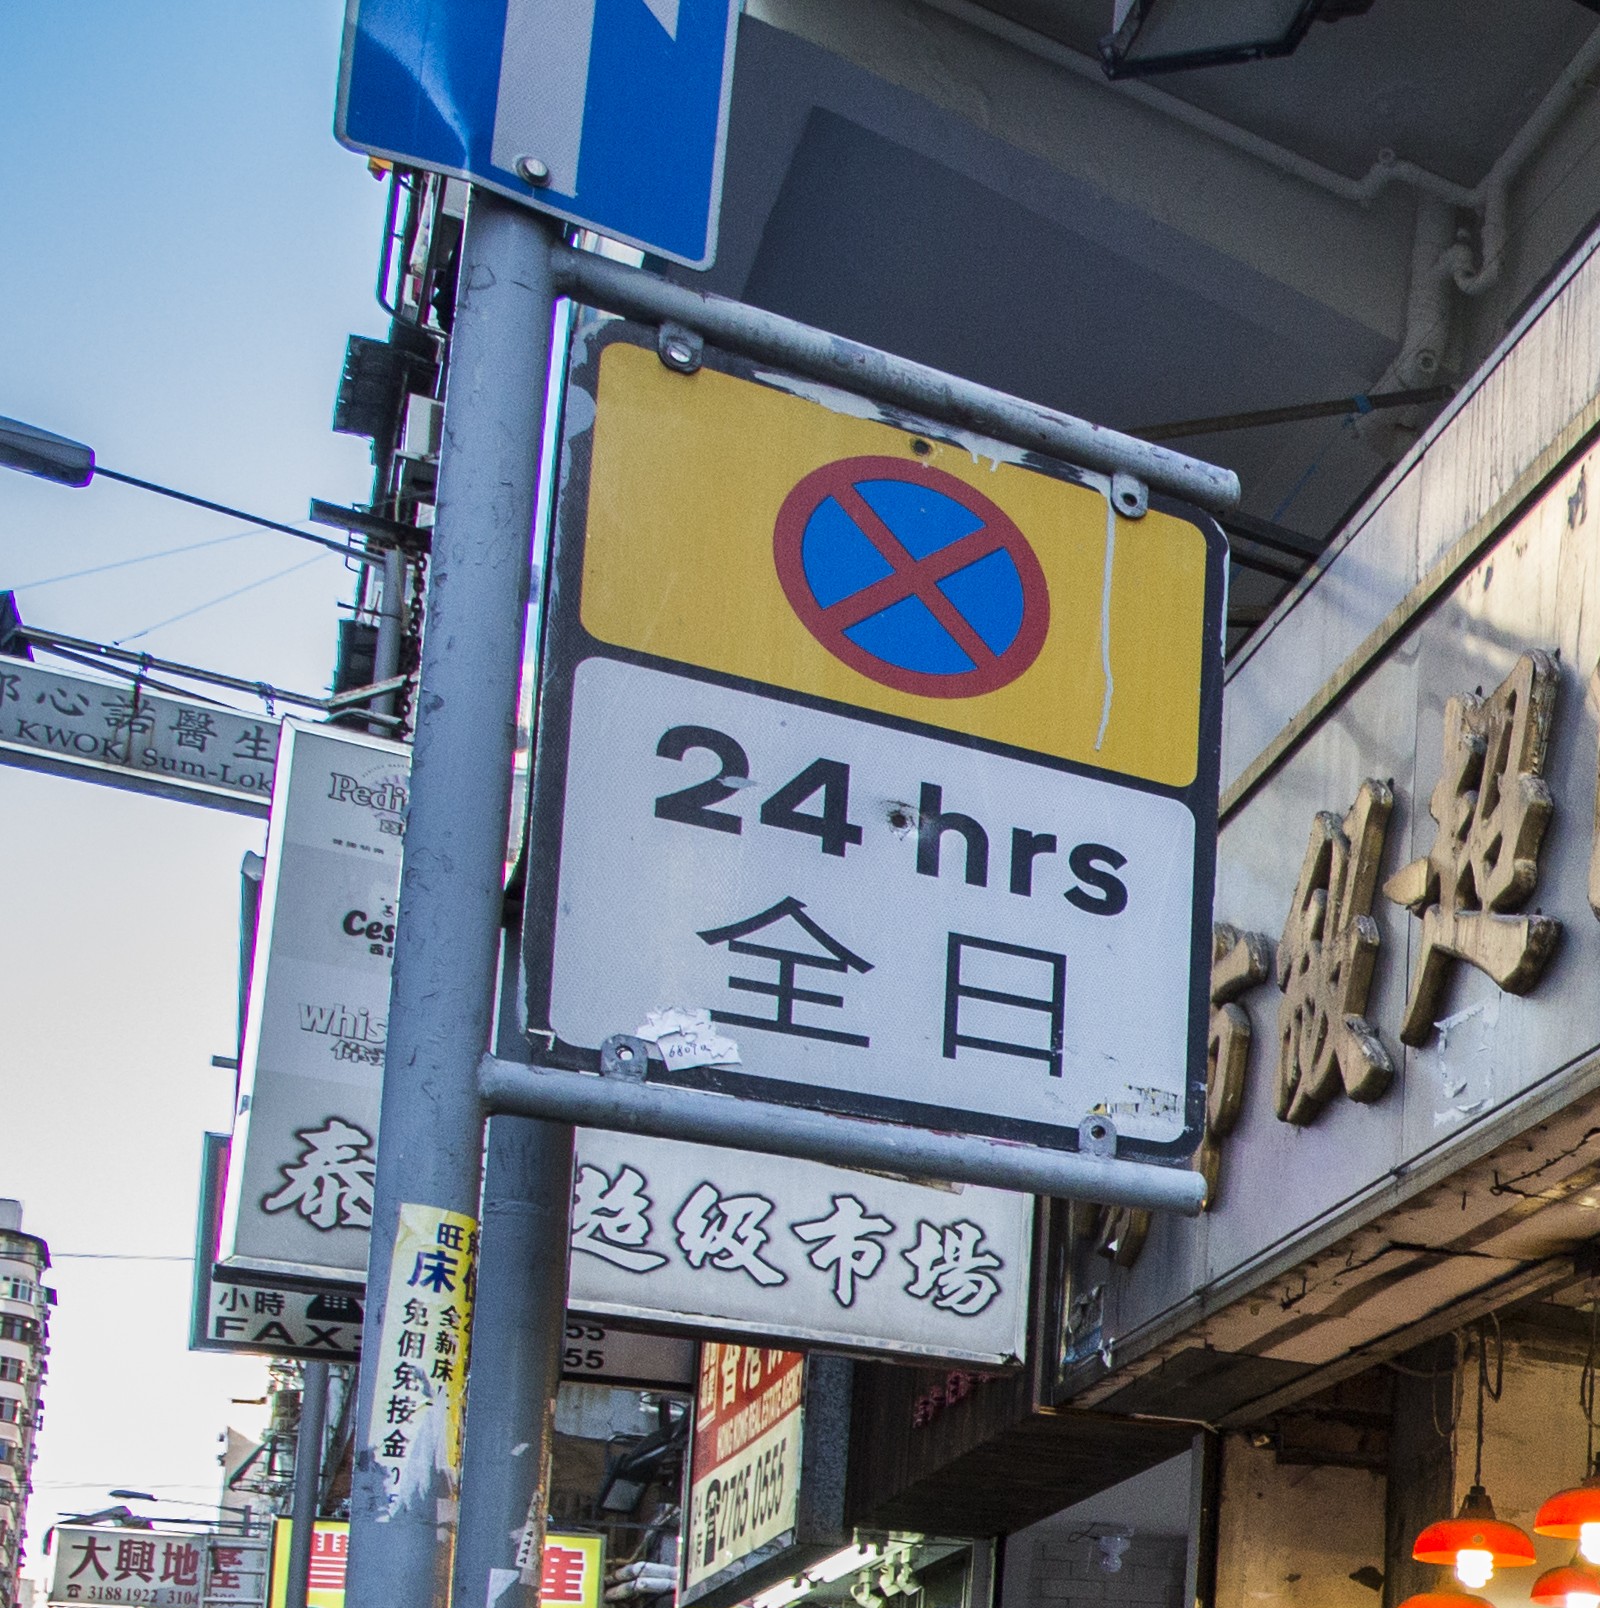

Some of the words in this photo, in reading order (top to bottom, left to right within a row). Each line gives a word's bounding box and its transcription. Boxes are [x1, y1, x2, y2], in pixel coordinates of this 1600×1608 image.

[142, 748, 272, 793] Sum-Lok
[654, 725, 863, 857] 24
[916, 781, 1129, 917] hrs
[696, 896, 1067, 1078] 全日
[261, 1116, 375, 1232] 泰
[574, 1164, 1001, 1315] 超級市場
[218, 1287, 285, 1317] 小時
[718, 1463, 752, 1552] 2765
[752, 1437, 787, 1531] 0555
